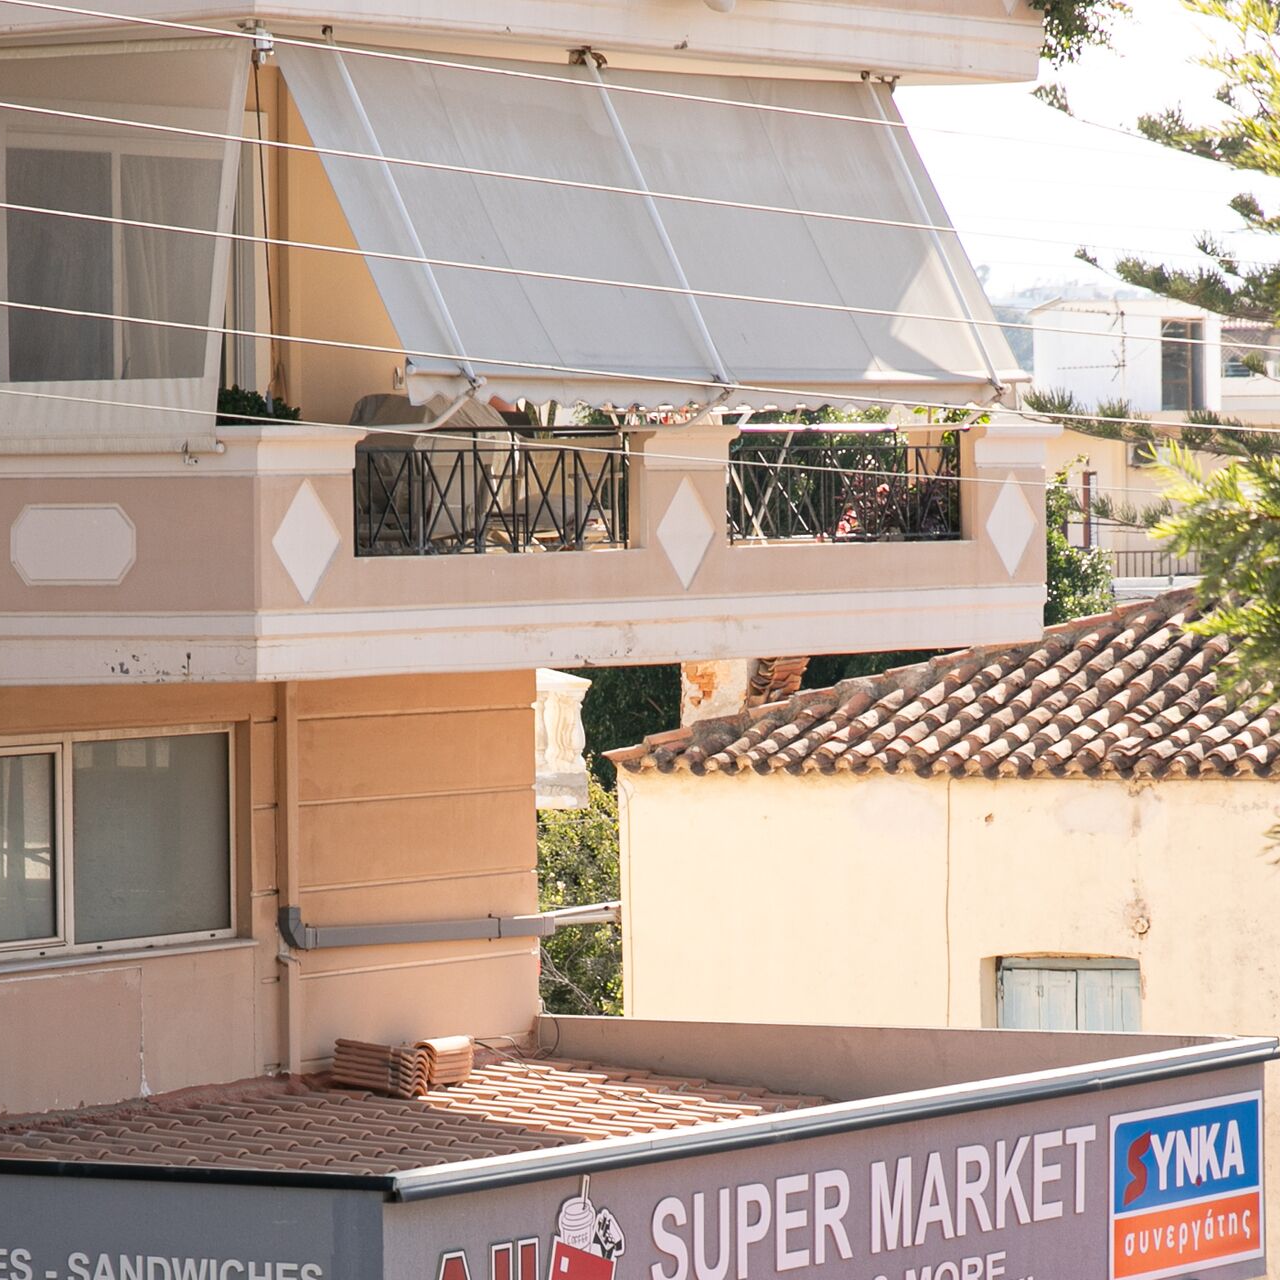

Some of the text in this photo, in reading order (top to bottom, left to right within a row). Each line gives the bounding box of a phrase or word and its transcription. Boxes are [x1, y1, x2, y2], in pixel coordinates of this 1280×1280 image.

[871, 1126, 1097, 1251] MARKET
[1123, 1120, 1245, 1206] SYNKA
[567, 1232, 588, 1245] COFFEE
[1124, 1209, 1251, 1257] συνεργάτης
